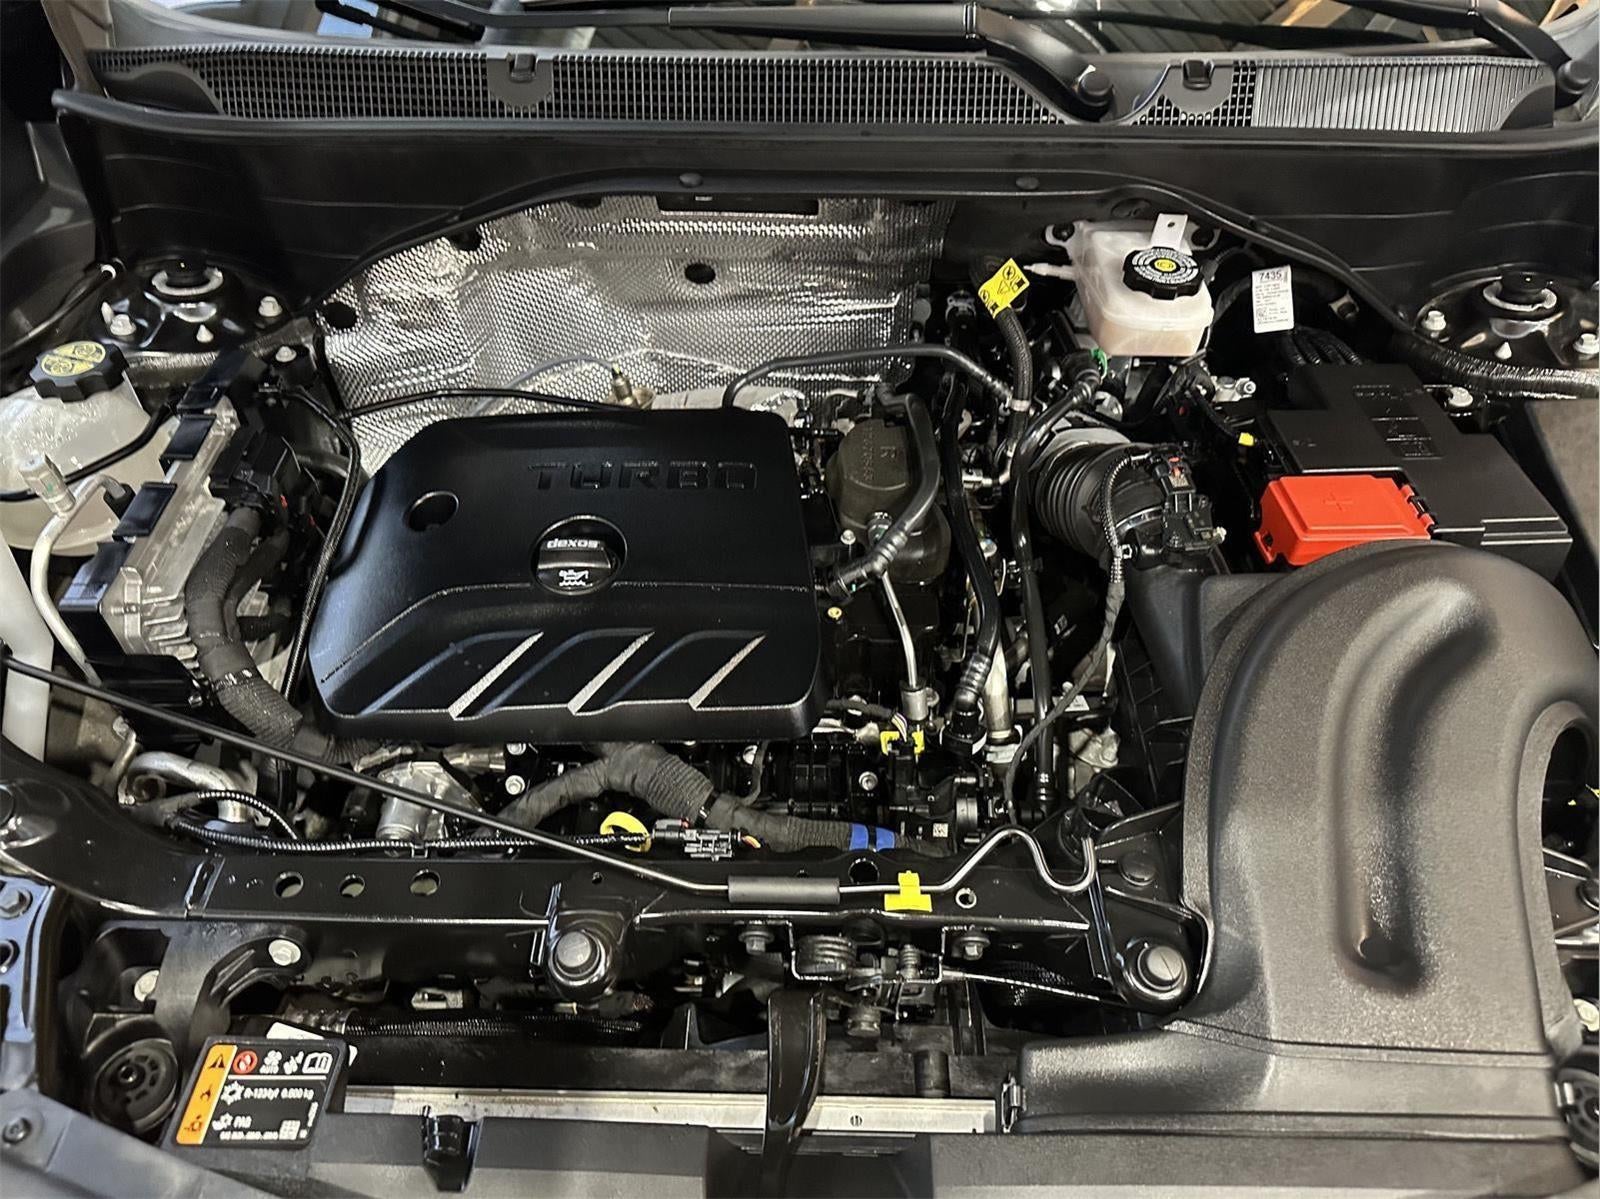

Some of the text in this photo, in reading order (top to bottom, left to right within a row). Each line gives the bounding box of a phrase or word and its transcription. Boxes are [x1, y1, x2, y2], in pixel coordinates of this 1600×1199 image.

[1260, 270, 1282, 280] 7435
[528, 461, 758, 490] TURBO
[547, 538, 599, 549] dexos
